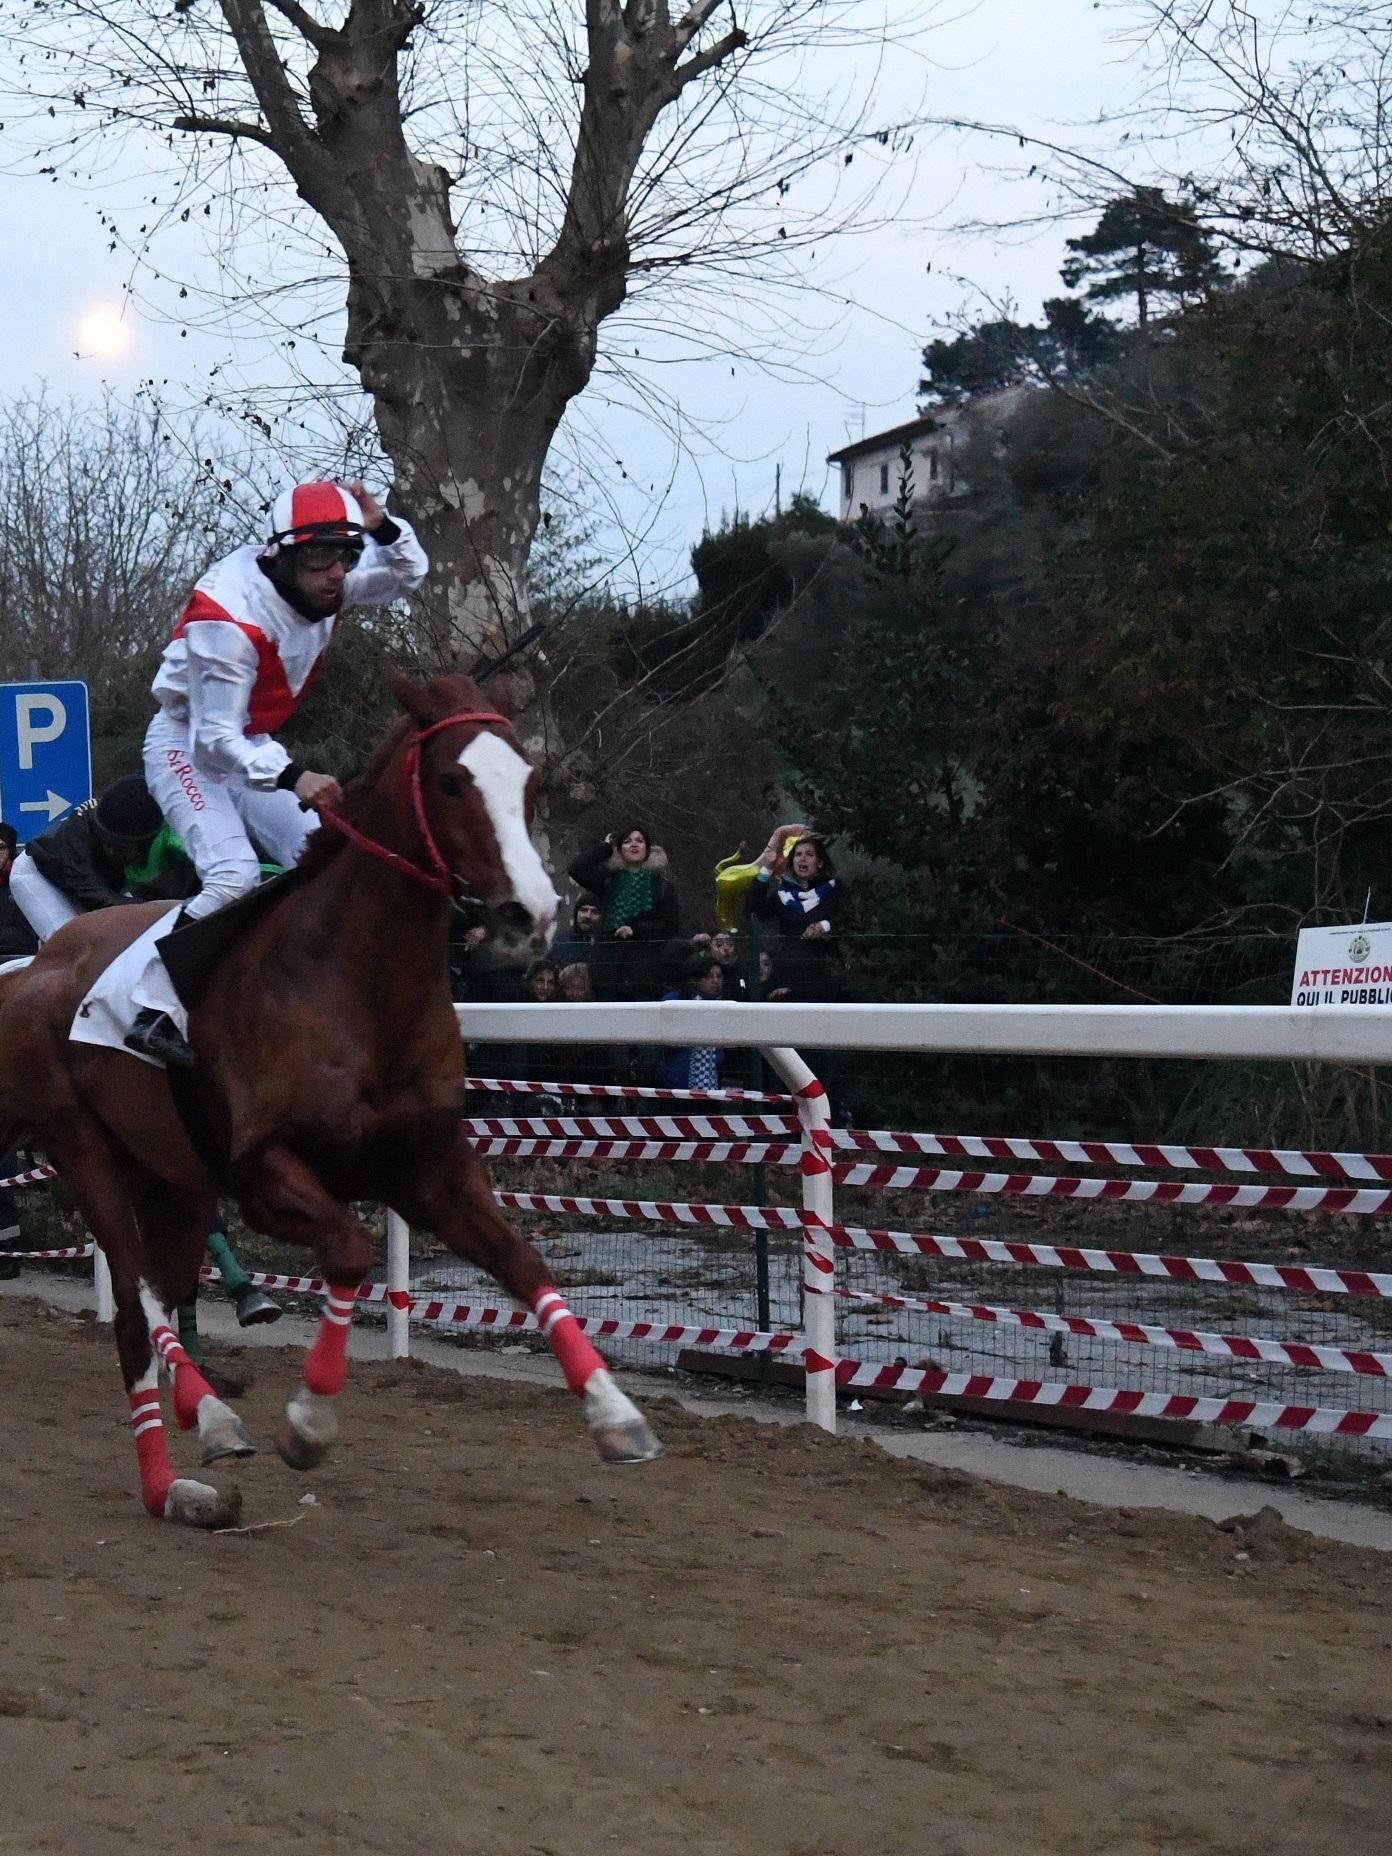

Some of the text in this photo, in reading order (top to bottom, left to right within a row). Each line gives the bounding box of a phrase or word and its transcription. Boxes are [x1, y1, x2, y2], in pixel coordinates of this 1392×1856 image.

[16, 693, 66, 769] P
[1299, 966, 1392, 987] ATTENZION
[1297, 992, 1319, 1006] QUI
[1324, 991, 1335, 1004] IL
